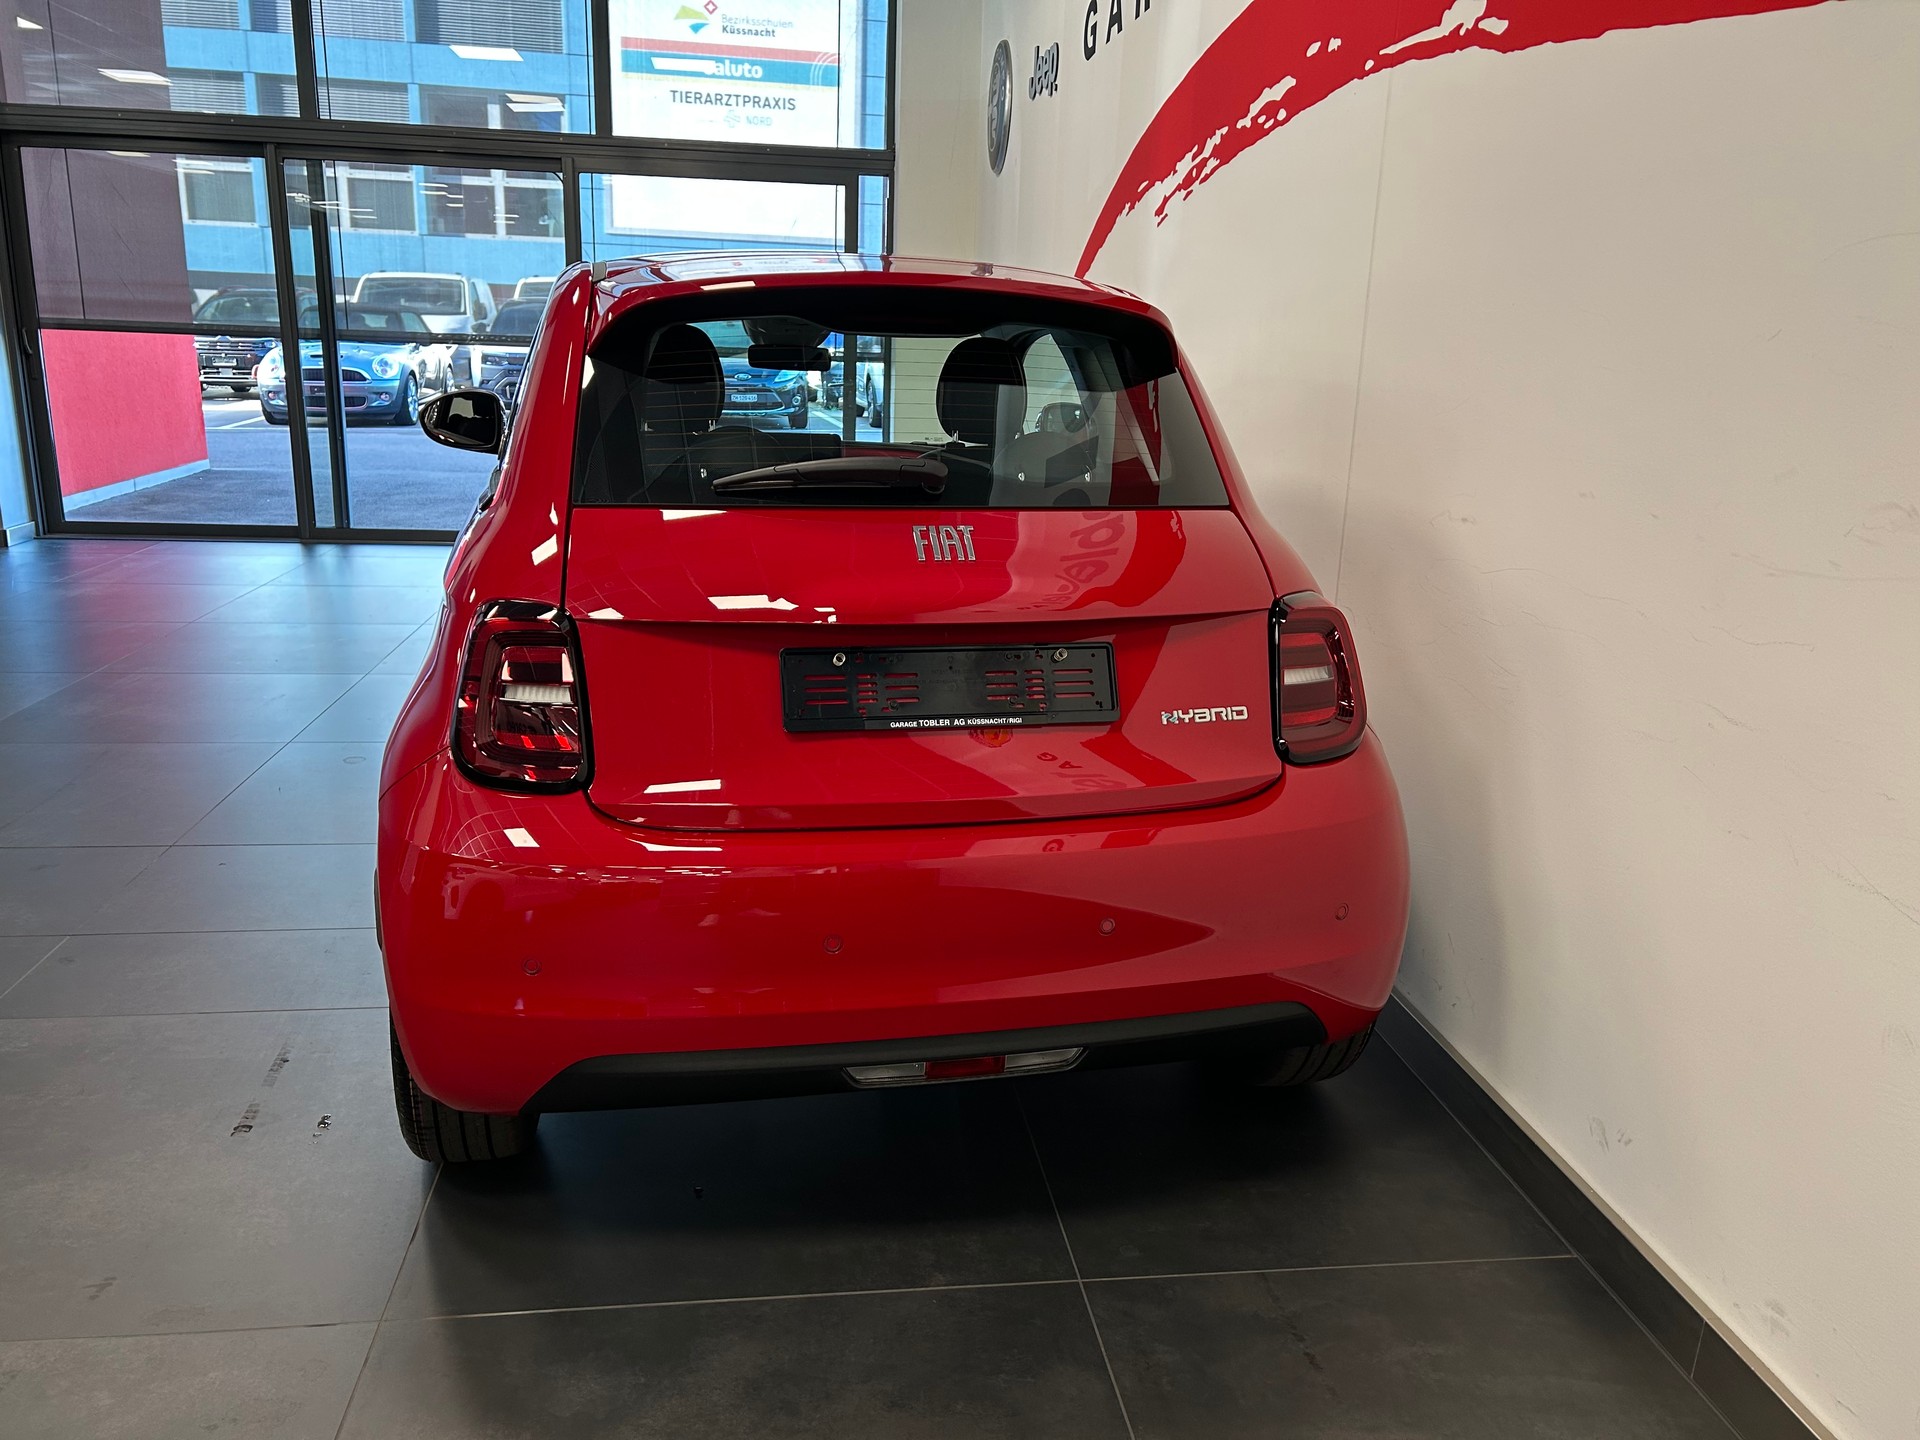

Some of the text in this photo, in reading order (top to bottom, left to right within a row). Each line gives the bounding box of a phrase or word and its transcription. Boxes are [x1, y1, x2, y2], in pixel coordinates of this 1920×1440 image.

[722, 24, 776, 38] Küssnacht
[1028, 42, 1060, 100] Jeep
[669, 89, 797, 111] TIERARZTPRAXIS
[912, 525, 976, 562] FIAT
[890, 717, 1023, 729] GARAGE TOBLER AG KÜSSNACHT/RIGI
[1160, 705, 1248, 725] HYBRID
